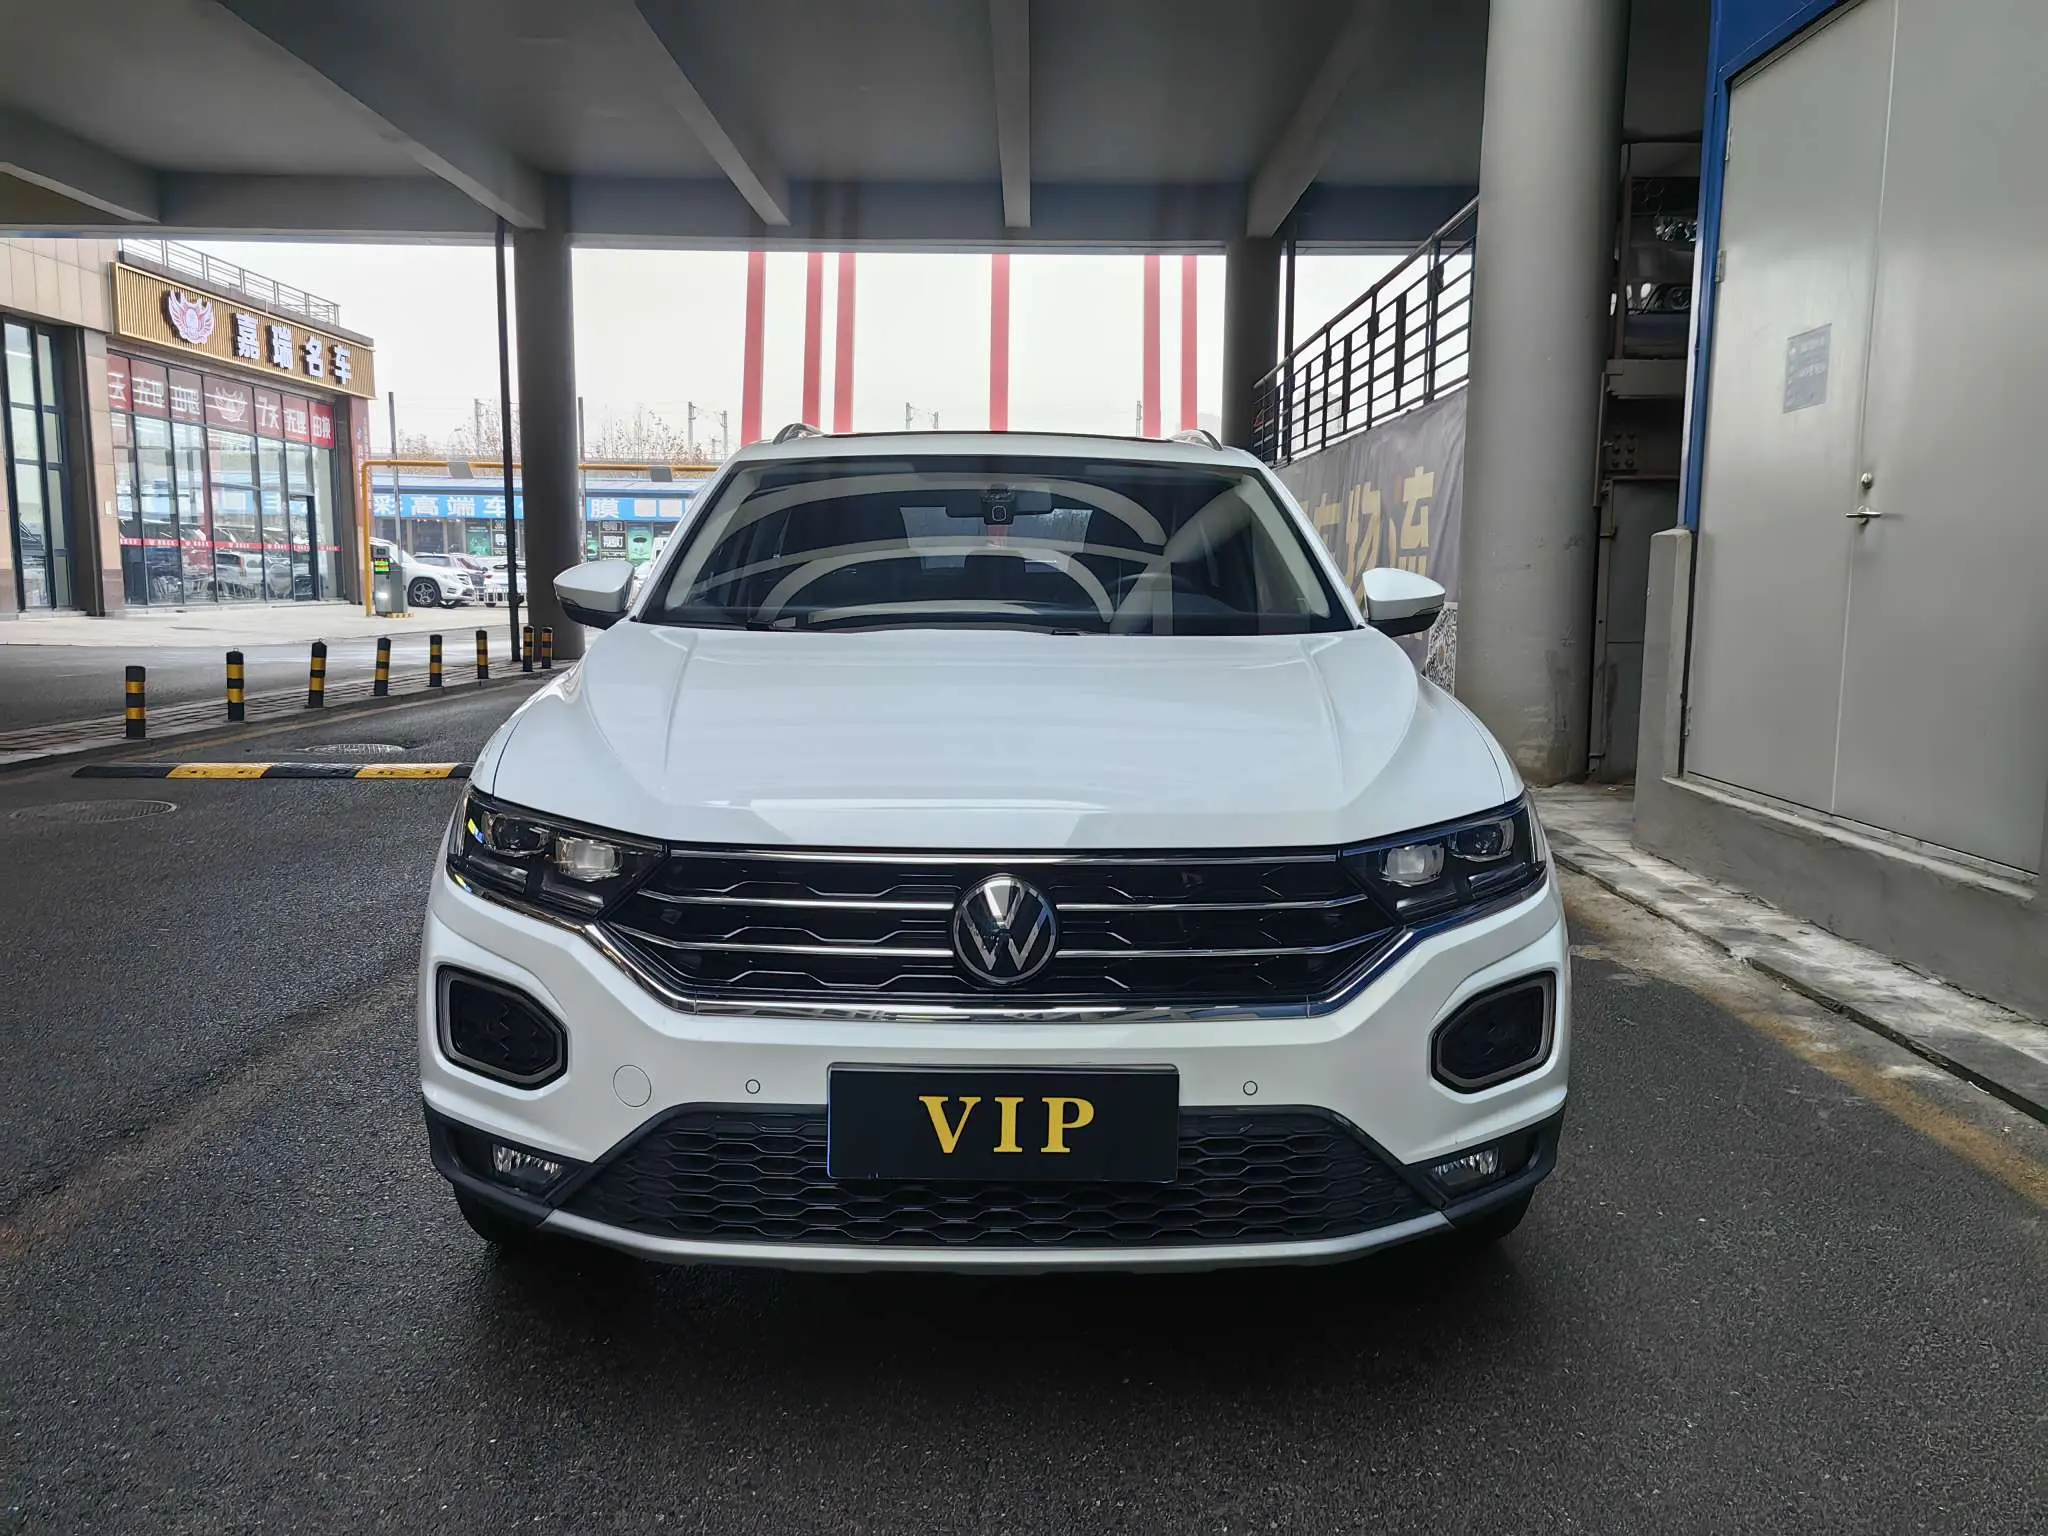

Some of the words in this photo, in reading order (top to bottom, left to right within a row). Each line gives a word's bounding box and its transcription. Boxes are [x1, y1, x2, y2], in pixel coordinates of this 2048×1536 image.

[236, 313, 352, 384] 嘉瑞名车
[918, 1095, 1096, 1154] VIP
